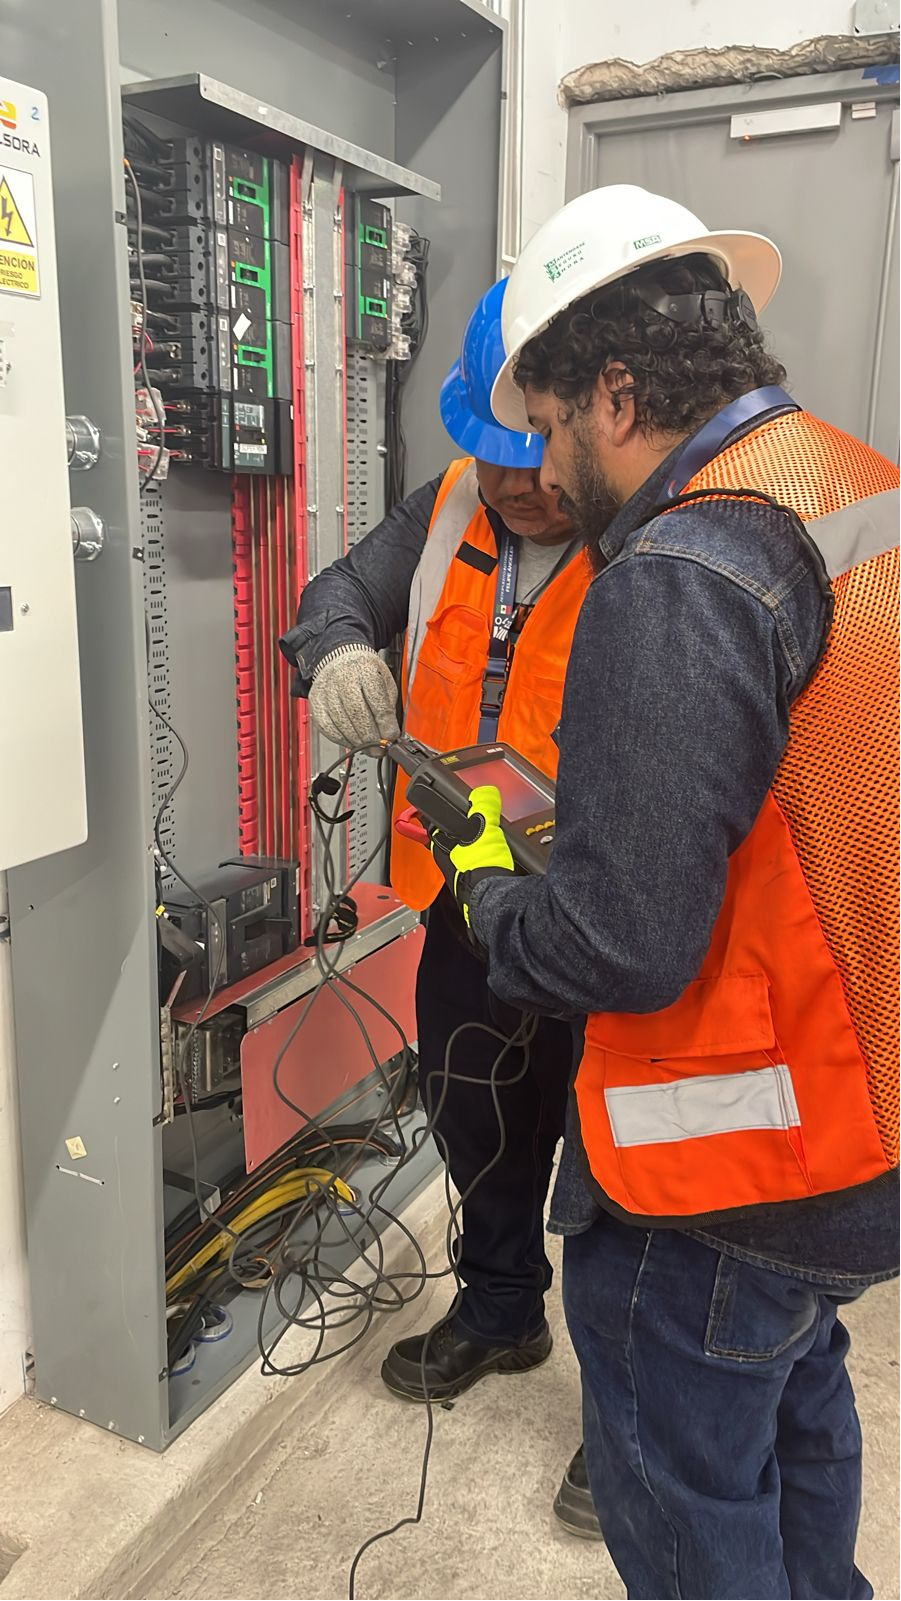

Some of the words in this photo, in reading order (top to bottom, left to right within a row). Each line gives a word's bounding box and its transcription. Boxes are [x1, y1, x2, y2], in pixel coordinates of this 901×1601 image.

[31, 107, 40, 121] 2
[0, 133, 41, 158] SORA
[635, 236, 660, 249] MSA
